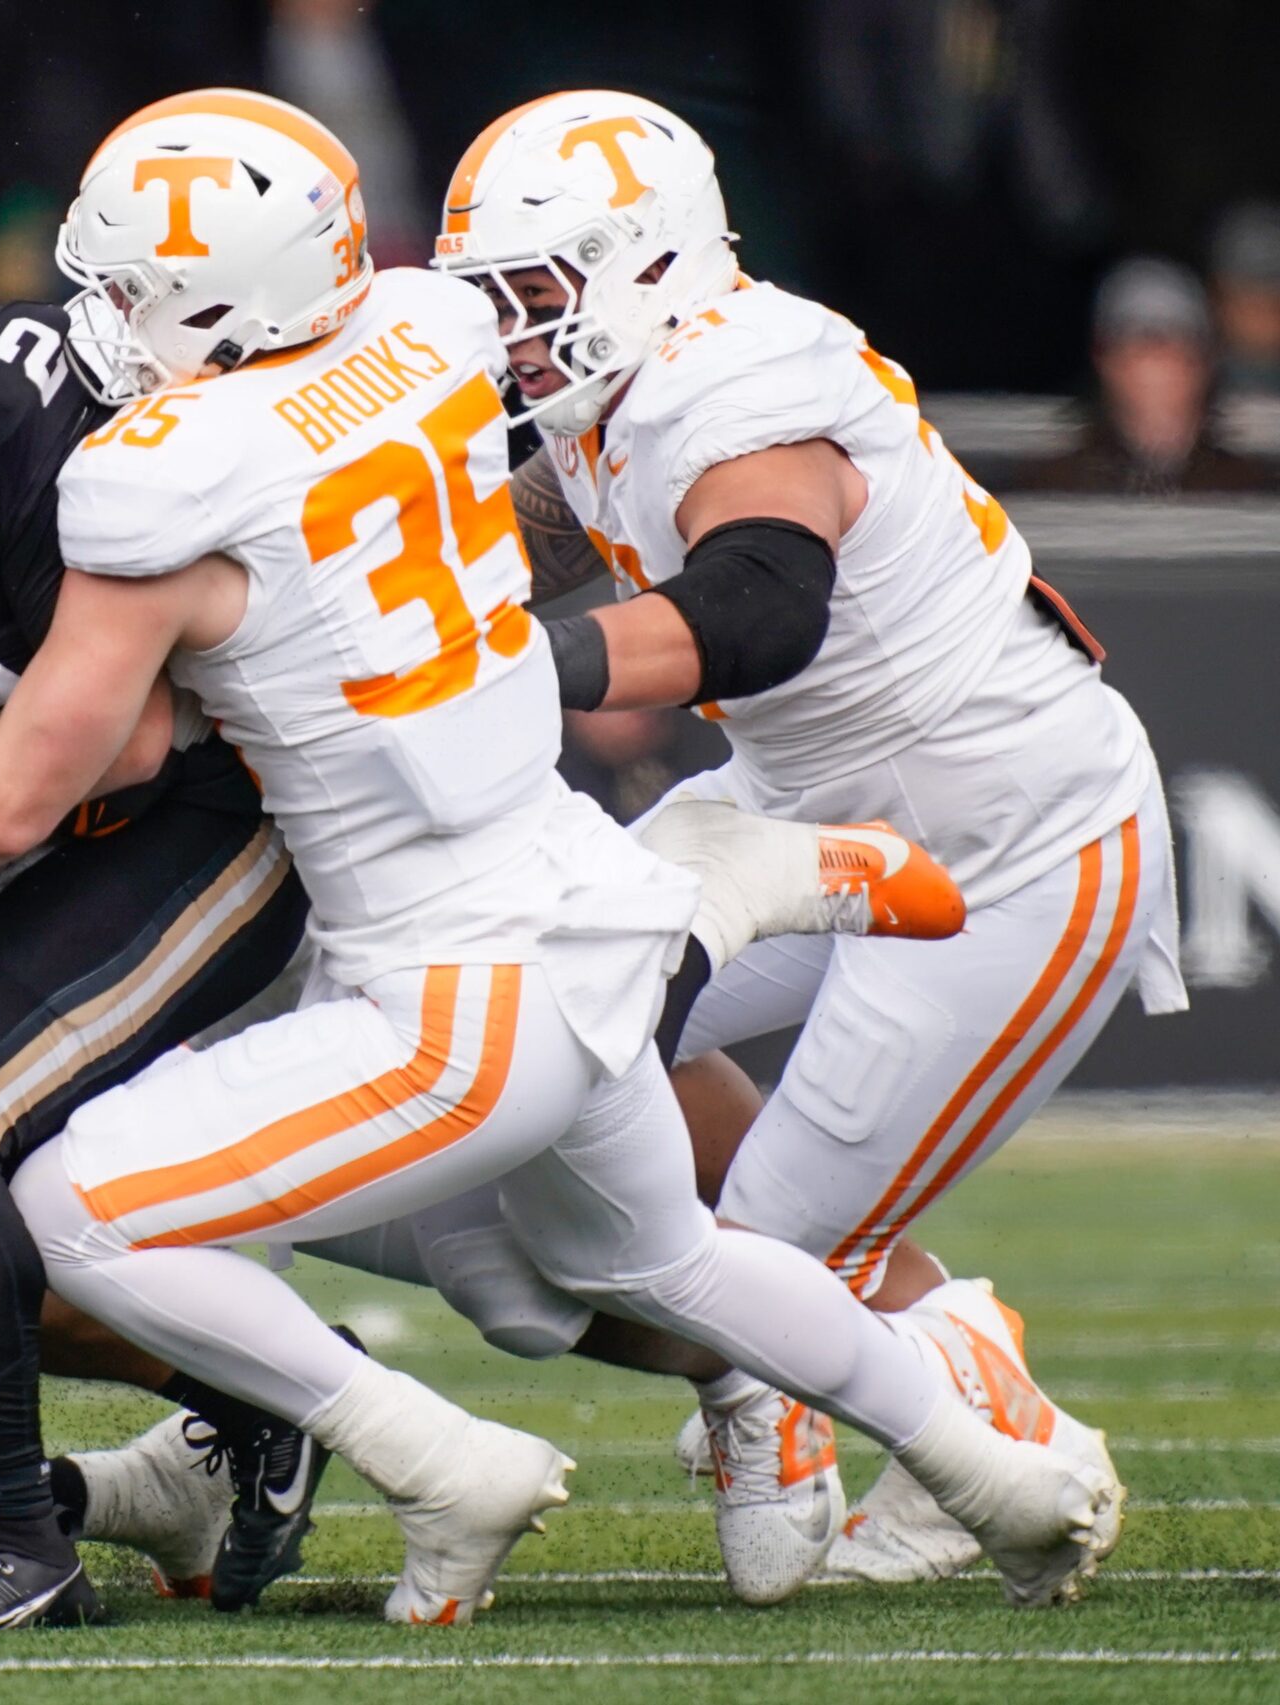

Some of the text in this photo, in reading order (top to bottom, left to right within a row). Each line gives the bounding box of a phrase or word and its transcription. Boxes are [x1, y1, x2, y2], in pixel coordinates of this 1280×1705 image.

[133, 156, 234, 257] T
[558, 116, 655, 209] T
[272, 321, 450, 455] BROOKS
[301, 369, 532, 718] 35
